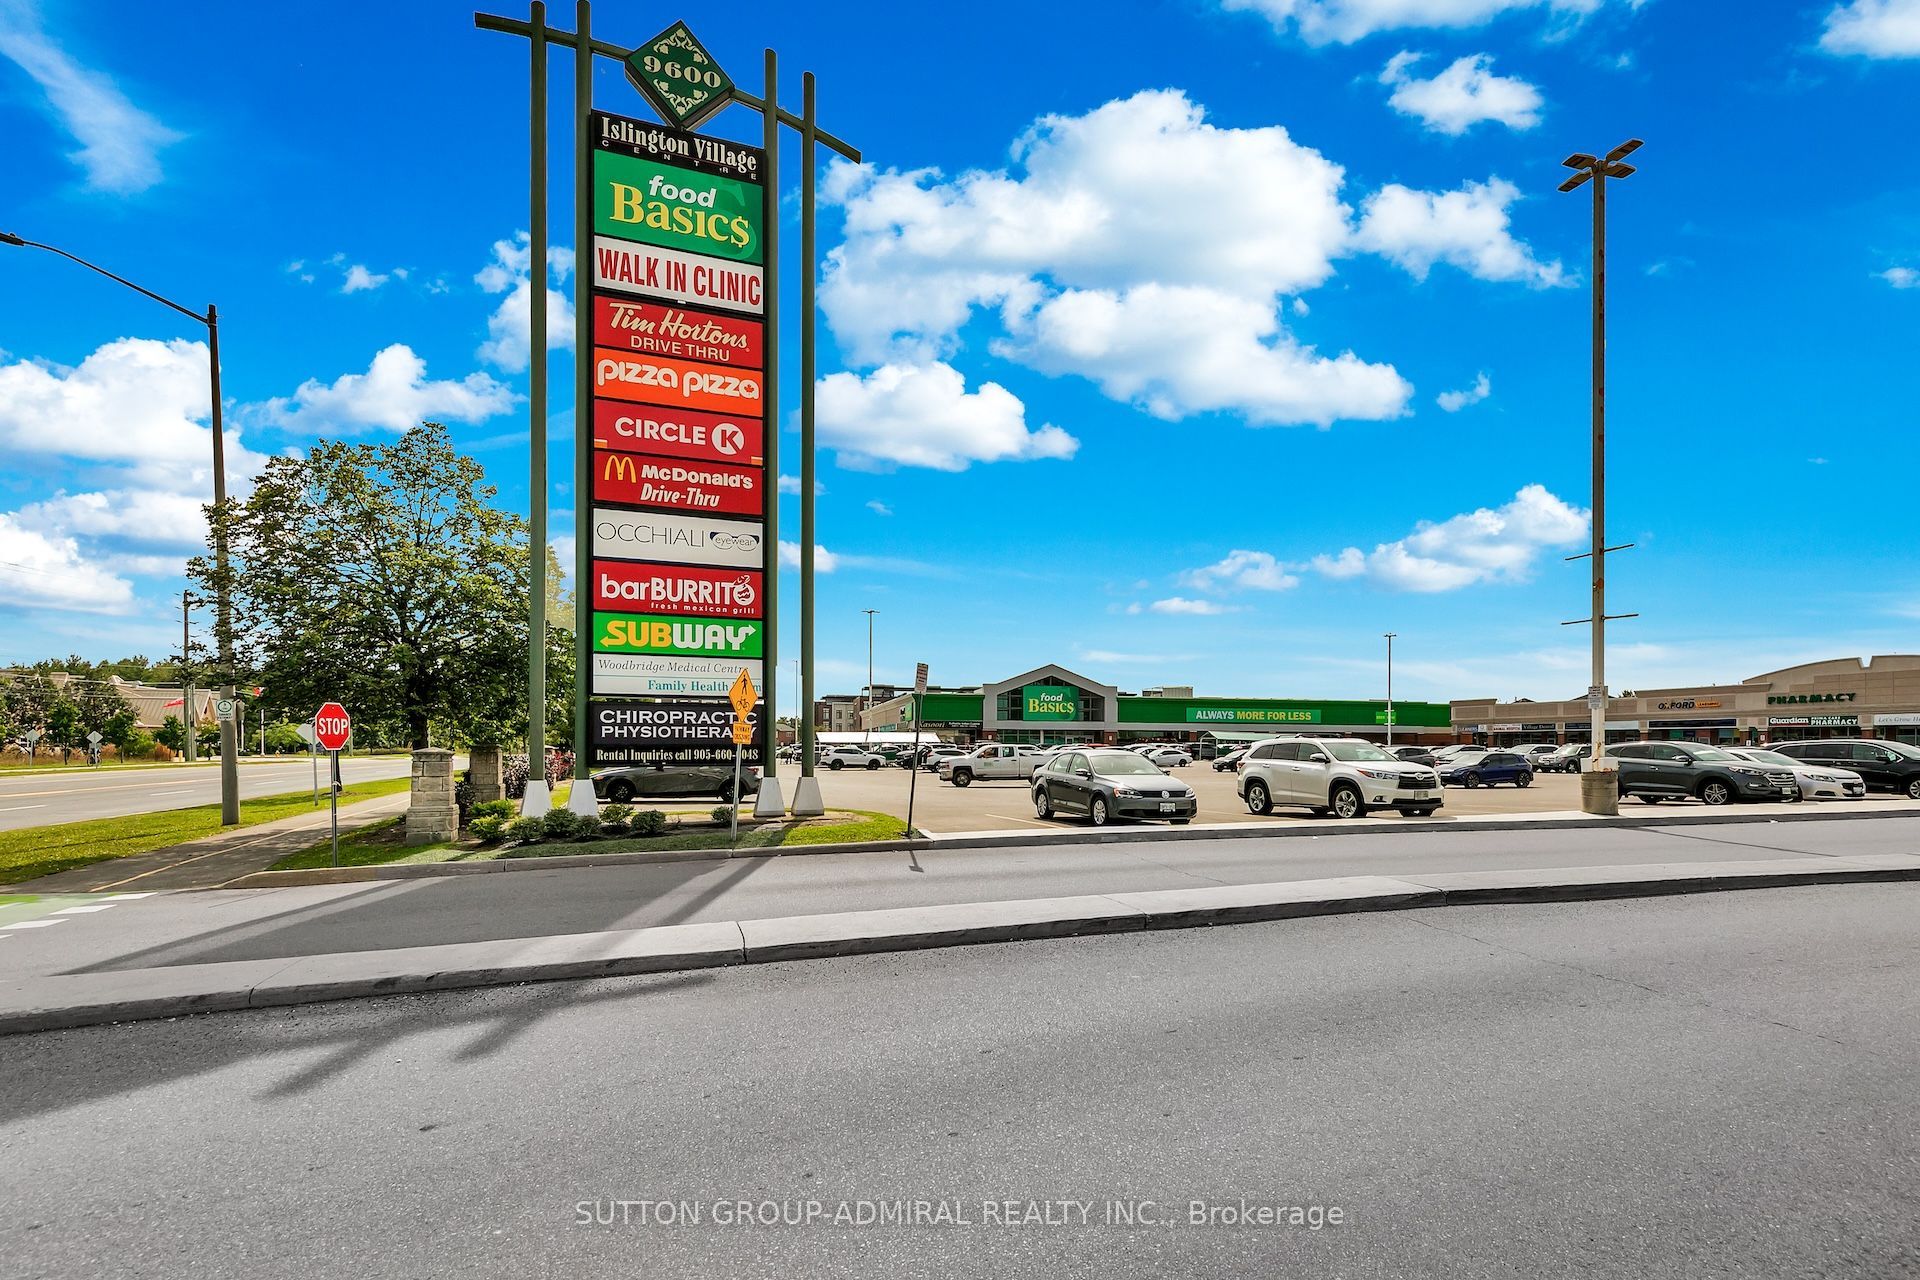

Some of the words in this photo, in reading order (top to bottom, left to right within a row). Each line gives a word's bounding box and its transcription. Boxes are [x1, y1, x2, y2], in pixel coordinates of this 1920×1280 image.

[643, 55, 721, 88] 9600
[602, 117, 689, 156] Islington
[694, 138, 757, 174] Village
[649, 175, 717, 208] food
[598, 248, 659, 287] WALK
[666, 261, 687, 293] IN
[693, 265, 761, 305] CLINIC
[609, 302, 656, 335] Tim
[659, 309, 748, 349] Hortons
[630, 335, 682, 355] DRIVE
[685, 343, 730, 361] THRU
[615, 417, 706, 445] CIRCLE
[718, 427, 743, 453] K
[641, 464, 753, 489] McDonald's
[640, 483, 720, 507] Drive-Thru
[596, 522, 705, 548] OCCHIALI
[715, 536, 756, 547] eyewear
[651, 602, 678, 610] fresh
[684, 605, 728, 614] mexican
[733, 607, 755, 615] grill
[600, 620, 756, 650] SUBWAY
[598, 659, 665, 672] Woodbridge
[667, 662, 711, 672] Medical
[713, 663, 749, 674] Centr
[648, 680, 687, 693] Family
[691, 682, 729, 692] Health
[1040, 692, 1063, 702] food
[1658, 702, 1695, 710] OXFORD
[1767, 693, 1856, 705] PHARMACY
[600, 710, 757, 725] CHIROPRACTC
[1195, 710, 1235, 720] ALWAYS
[1236, 710, 1265, 720] MORE
[1267, 711, 1286, 721] FOR
[1288, 711, 1311, 721] LESS
[1769, 717, 1809, 725] Guardian
[318, 717, 348, 735] STOP
[601, 726, 757, 739] PHYSIOTHERAY
[596, 749, 628, 761] Rental
[631, 749, 673, 763] Inquiries
[675, 749, 692, 760] call
[694, 749, 759, 761] 905-660-048
